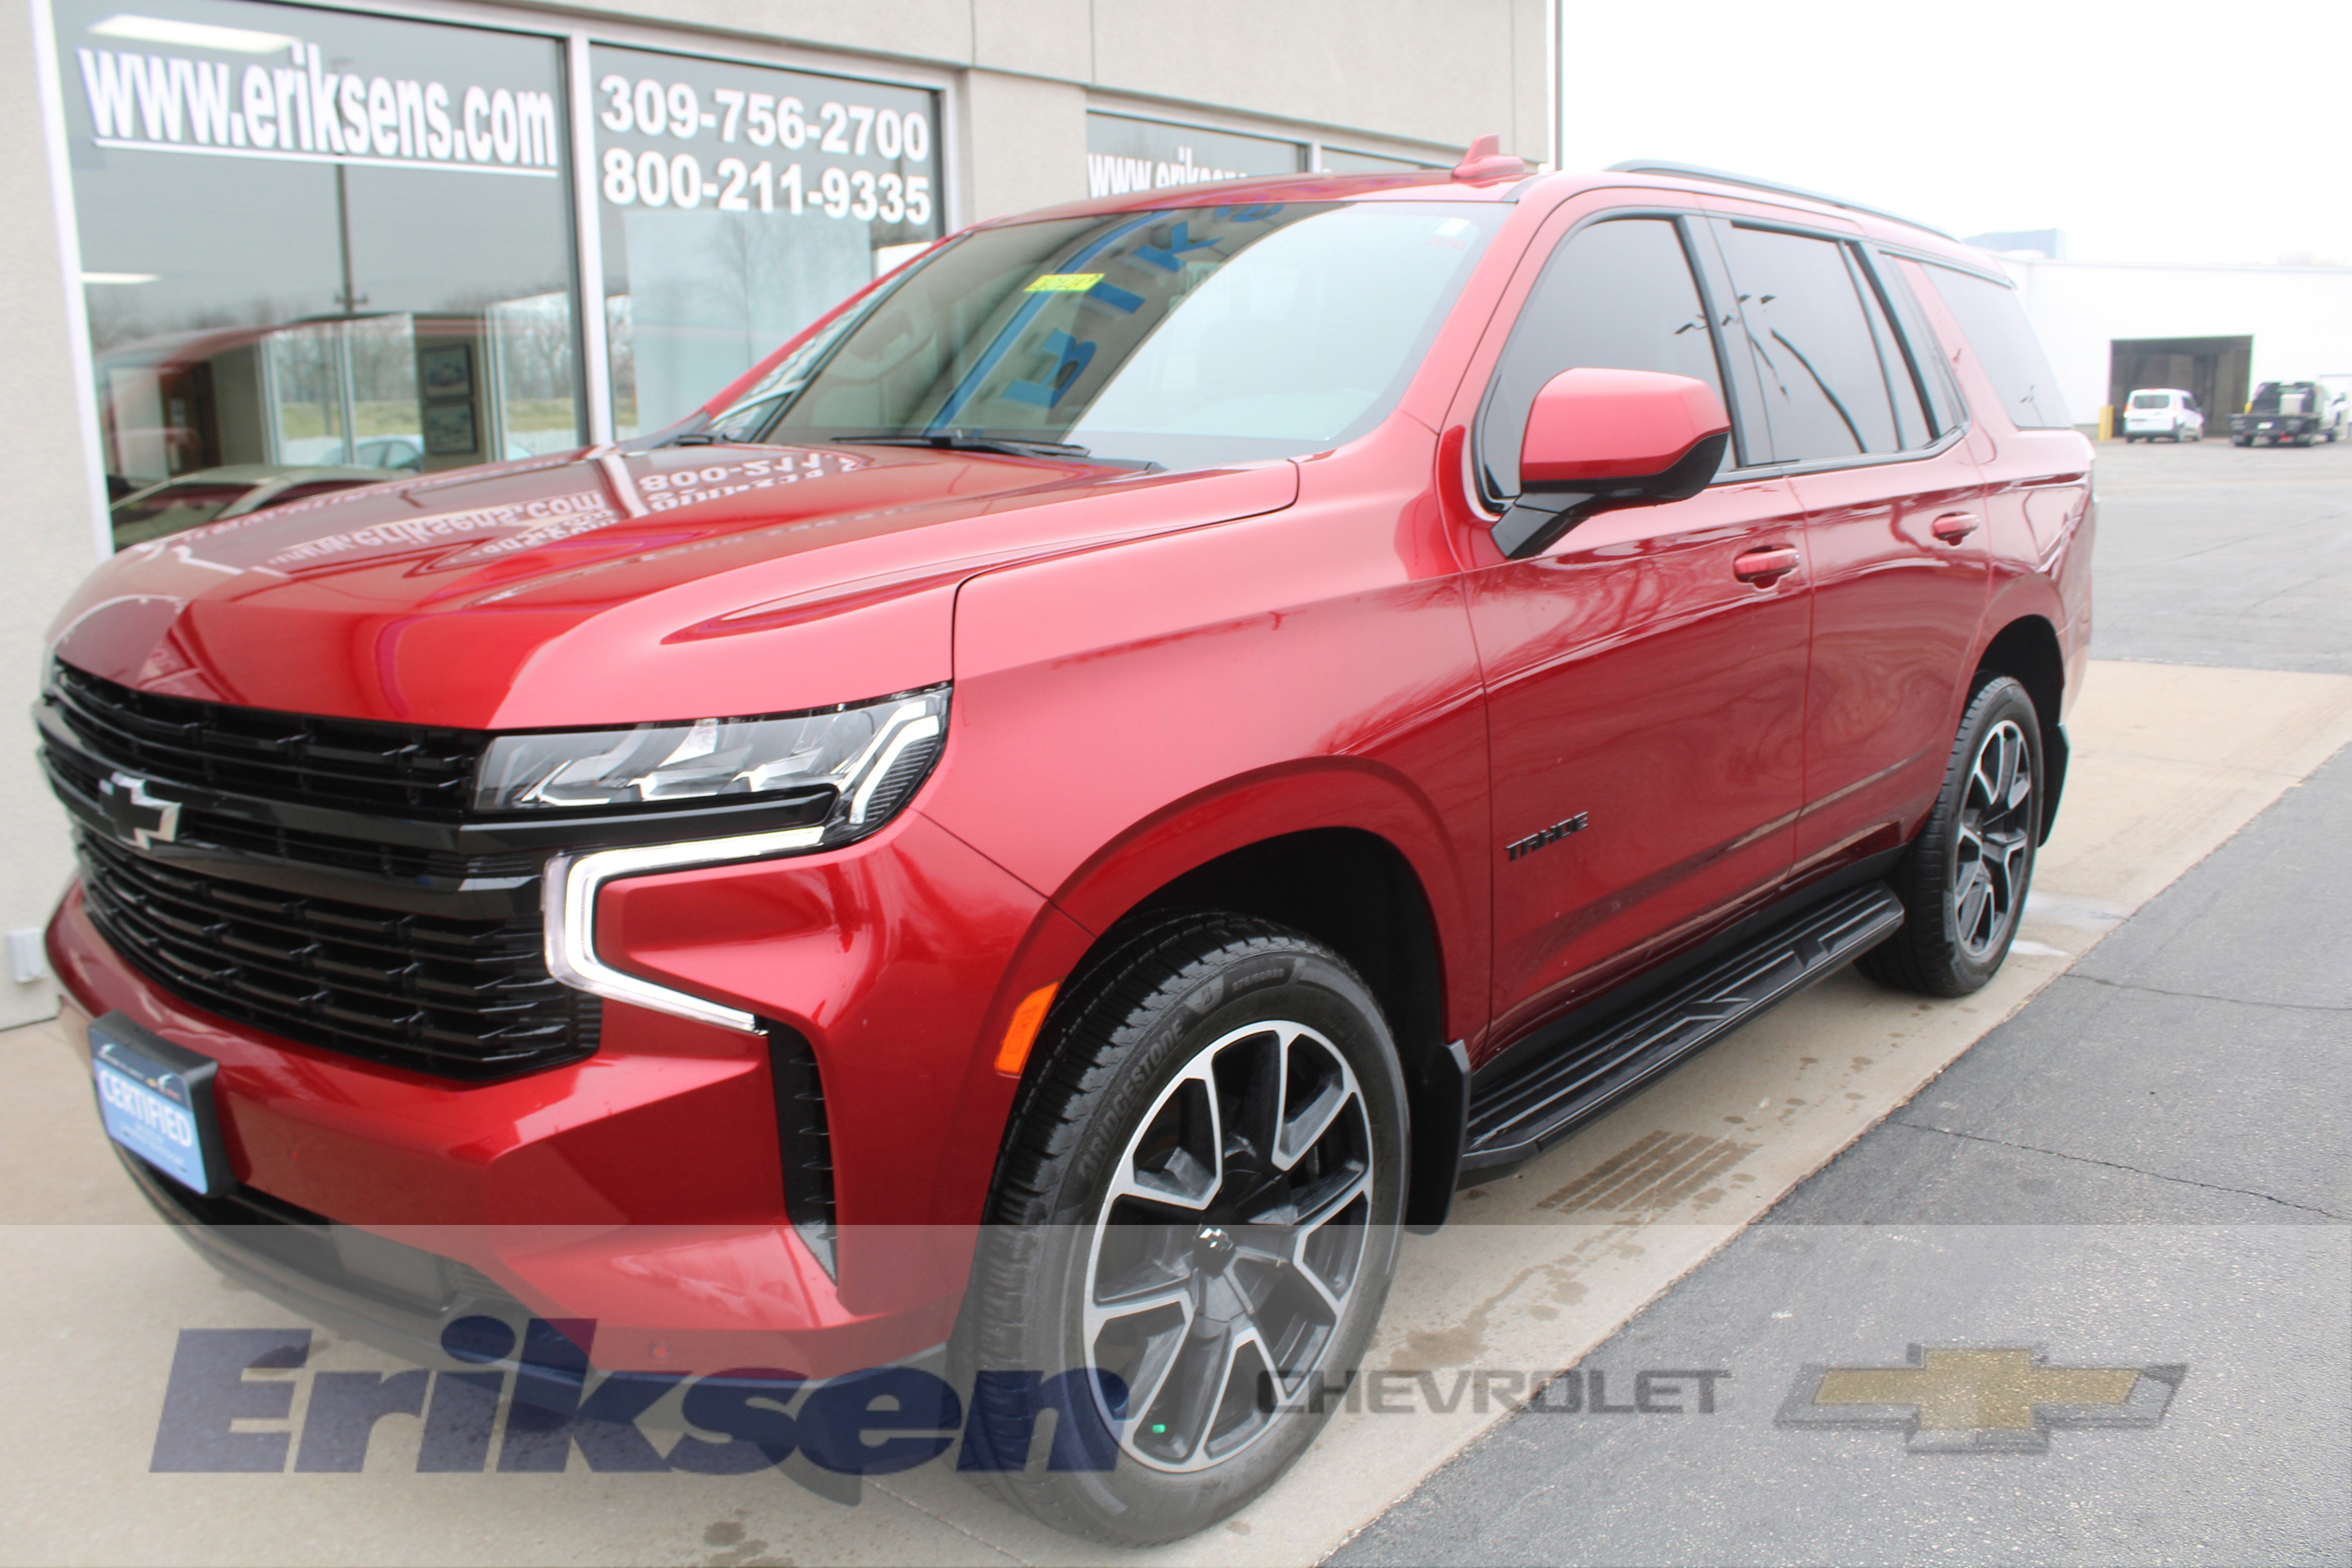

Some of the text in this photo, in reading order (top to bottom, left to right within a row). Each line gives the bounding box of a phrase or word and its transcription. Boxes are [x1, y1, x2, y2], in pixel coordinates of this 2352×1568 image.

[77, 40, 559, 166] www.eriksens.com
[600, 75, 929, 163] 309-756-2700
[603, 147, 931, 225] 800-211-9335
[1506, 811, 1588, 862] TAHOE
[99, 1069, 192, 1148] CERTIFIED
[1080, 1018, 1184, 1179] BRIDGESTONE
